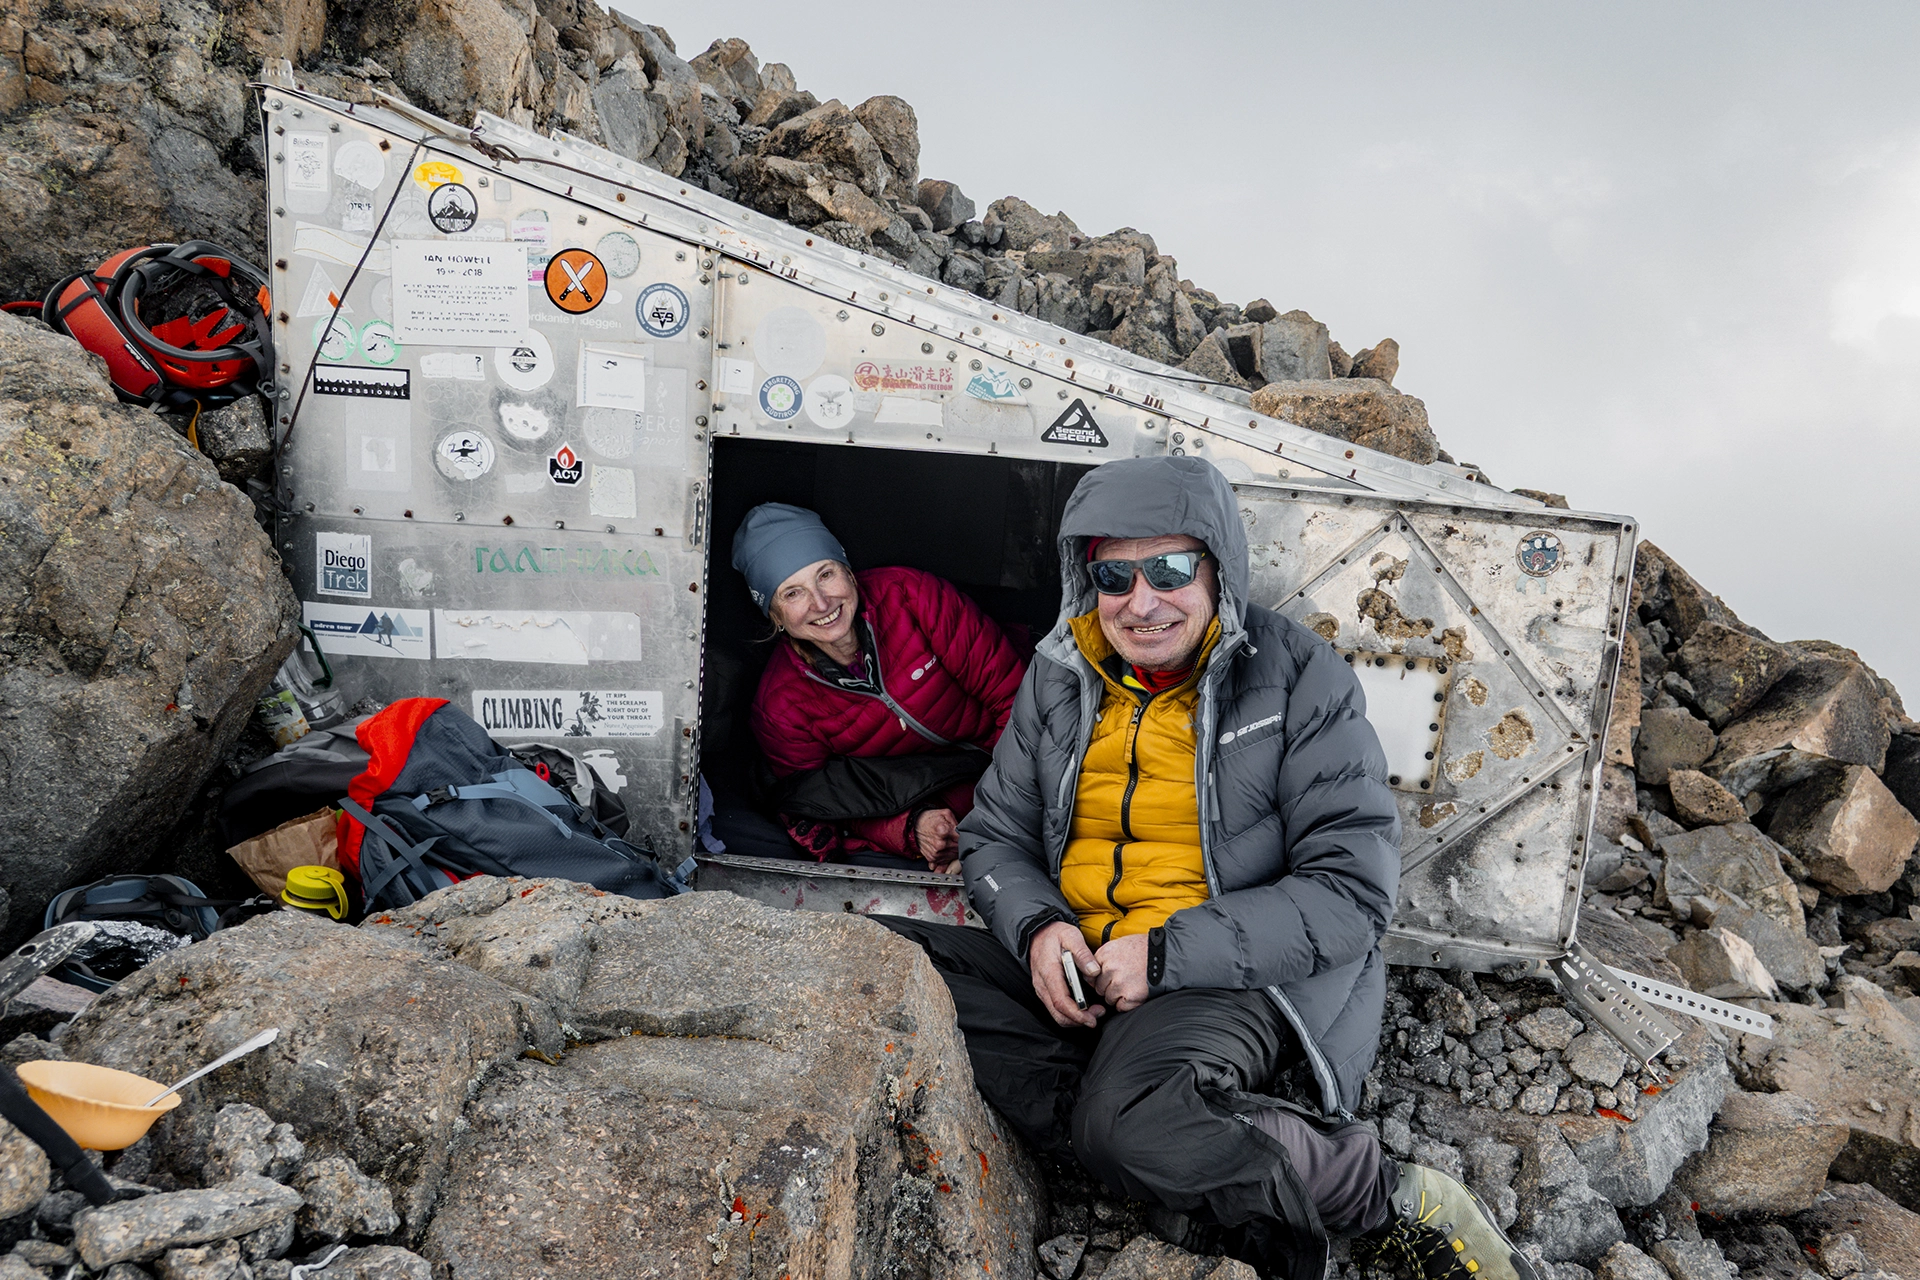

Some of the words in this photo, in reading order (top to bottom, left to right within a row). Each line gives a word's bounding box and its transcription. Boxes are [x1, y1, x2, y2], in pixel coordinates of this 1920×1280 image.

[317, 386, 405, 396] PROFESSIONAL
[762, 377, 801, 396] BERGRETTUNG
[765, 405, 796, 418] SÜDTIROL
[553, 469, 579, 480] ACV
[325, 550, 365, 572] Diego
[325, 570, 366, 590] Trek
[482, 697, 563, 730] CLIMBING
